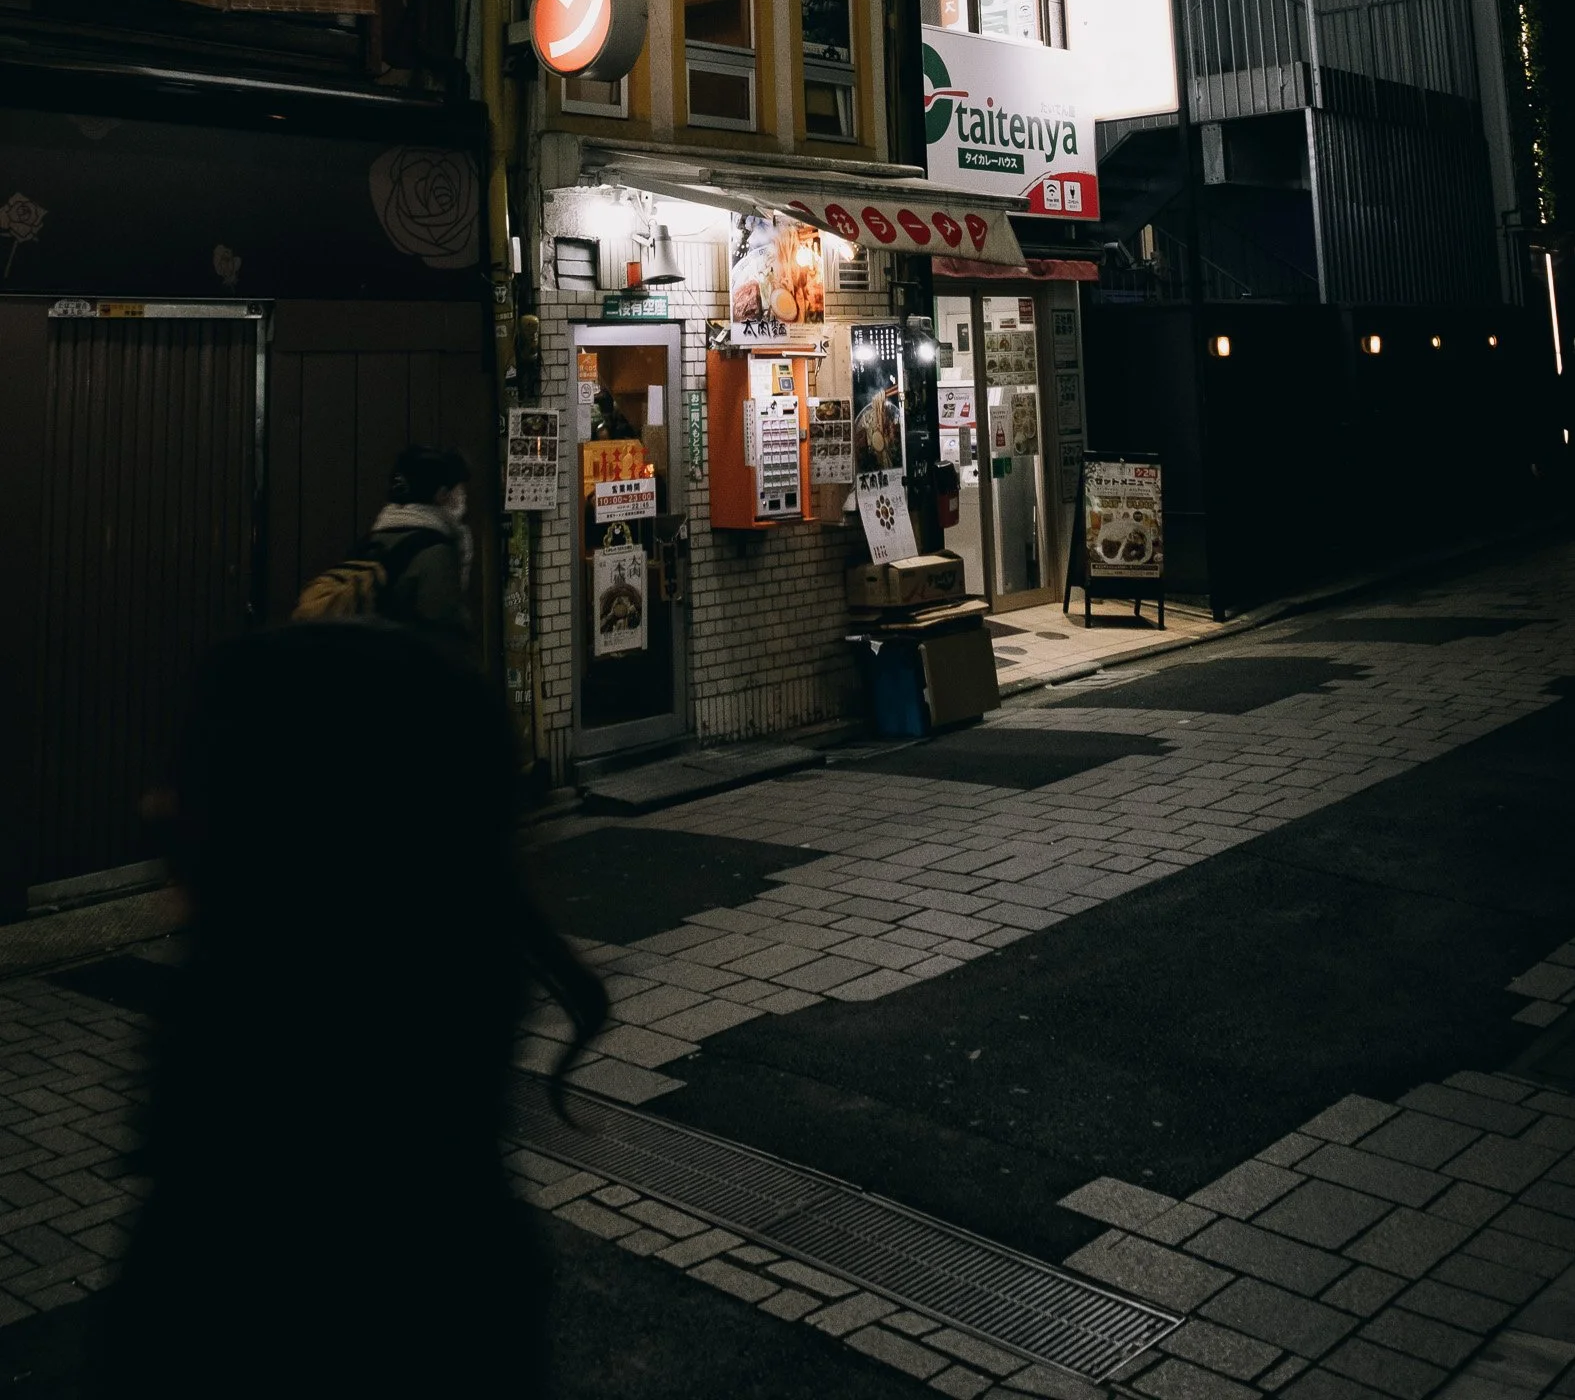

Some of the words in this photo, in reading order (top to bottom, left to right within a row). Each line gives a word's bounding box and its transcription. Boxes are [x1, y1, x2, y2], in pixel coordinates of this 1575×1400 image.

[955, 97, 1078, 162] taitenya
[965, 152, 1018, 169] タイカレーハウス
[611, 482, 641, 494] 営業時間
